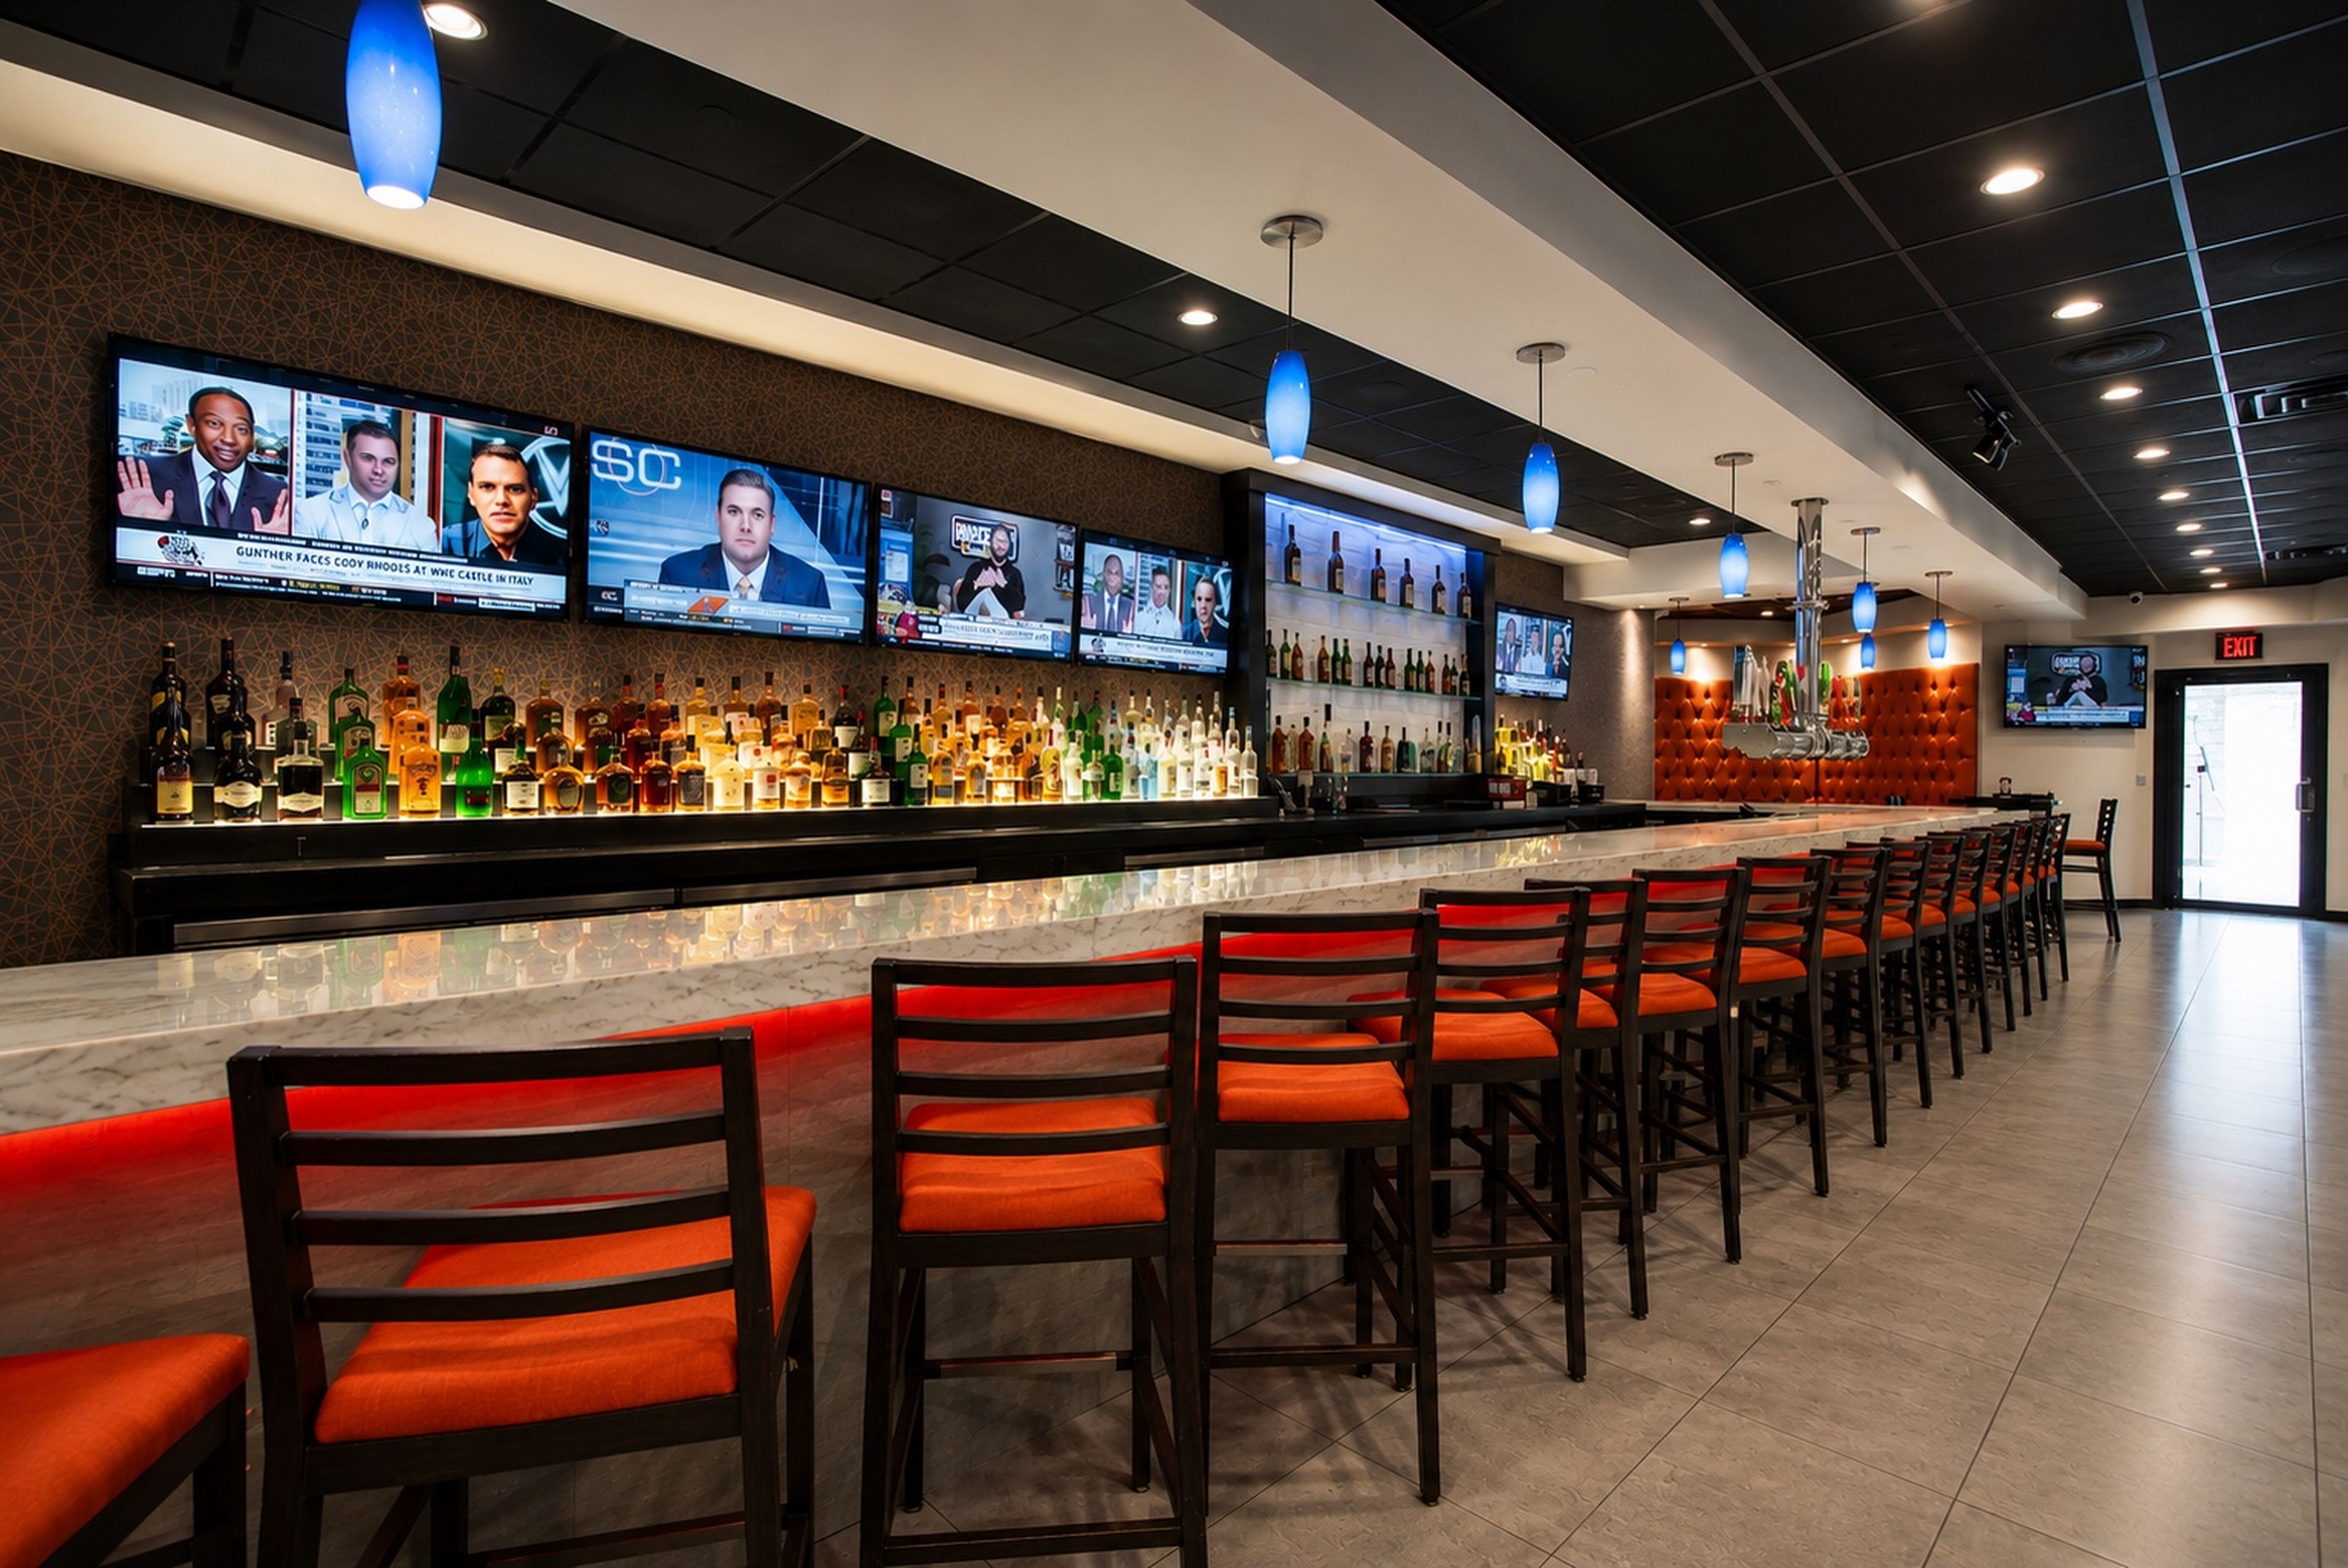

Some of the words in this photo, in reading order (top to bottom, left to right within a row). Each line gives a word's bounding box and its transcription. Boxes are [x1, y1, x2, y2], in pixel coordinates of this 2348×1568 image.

[591, 439, 681, 490] SC
[236, 546, 293, 562] GUNTHER
[413, 565, 427, 575] AT
[496, 574, 507, 583] IN
[509, 575, 533, 586] ITALY
[2223, 636, 2257, 658] EXIT
